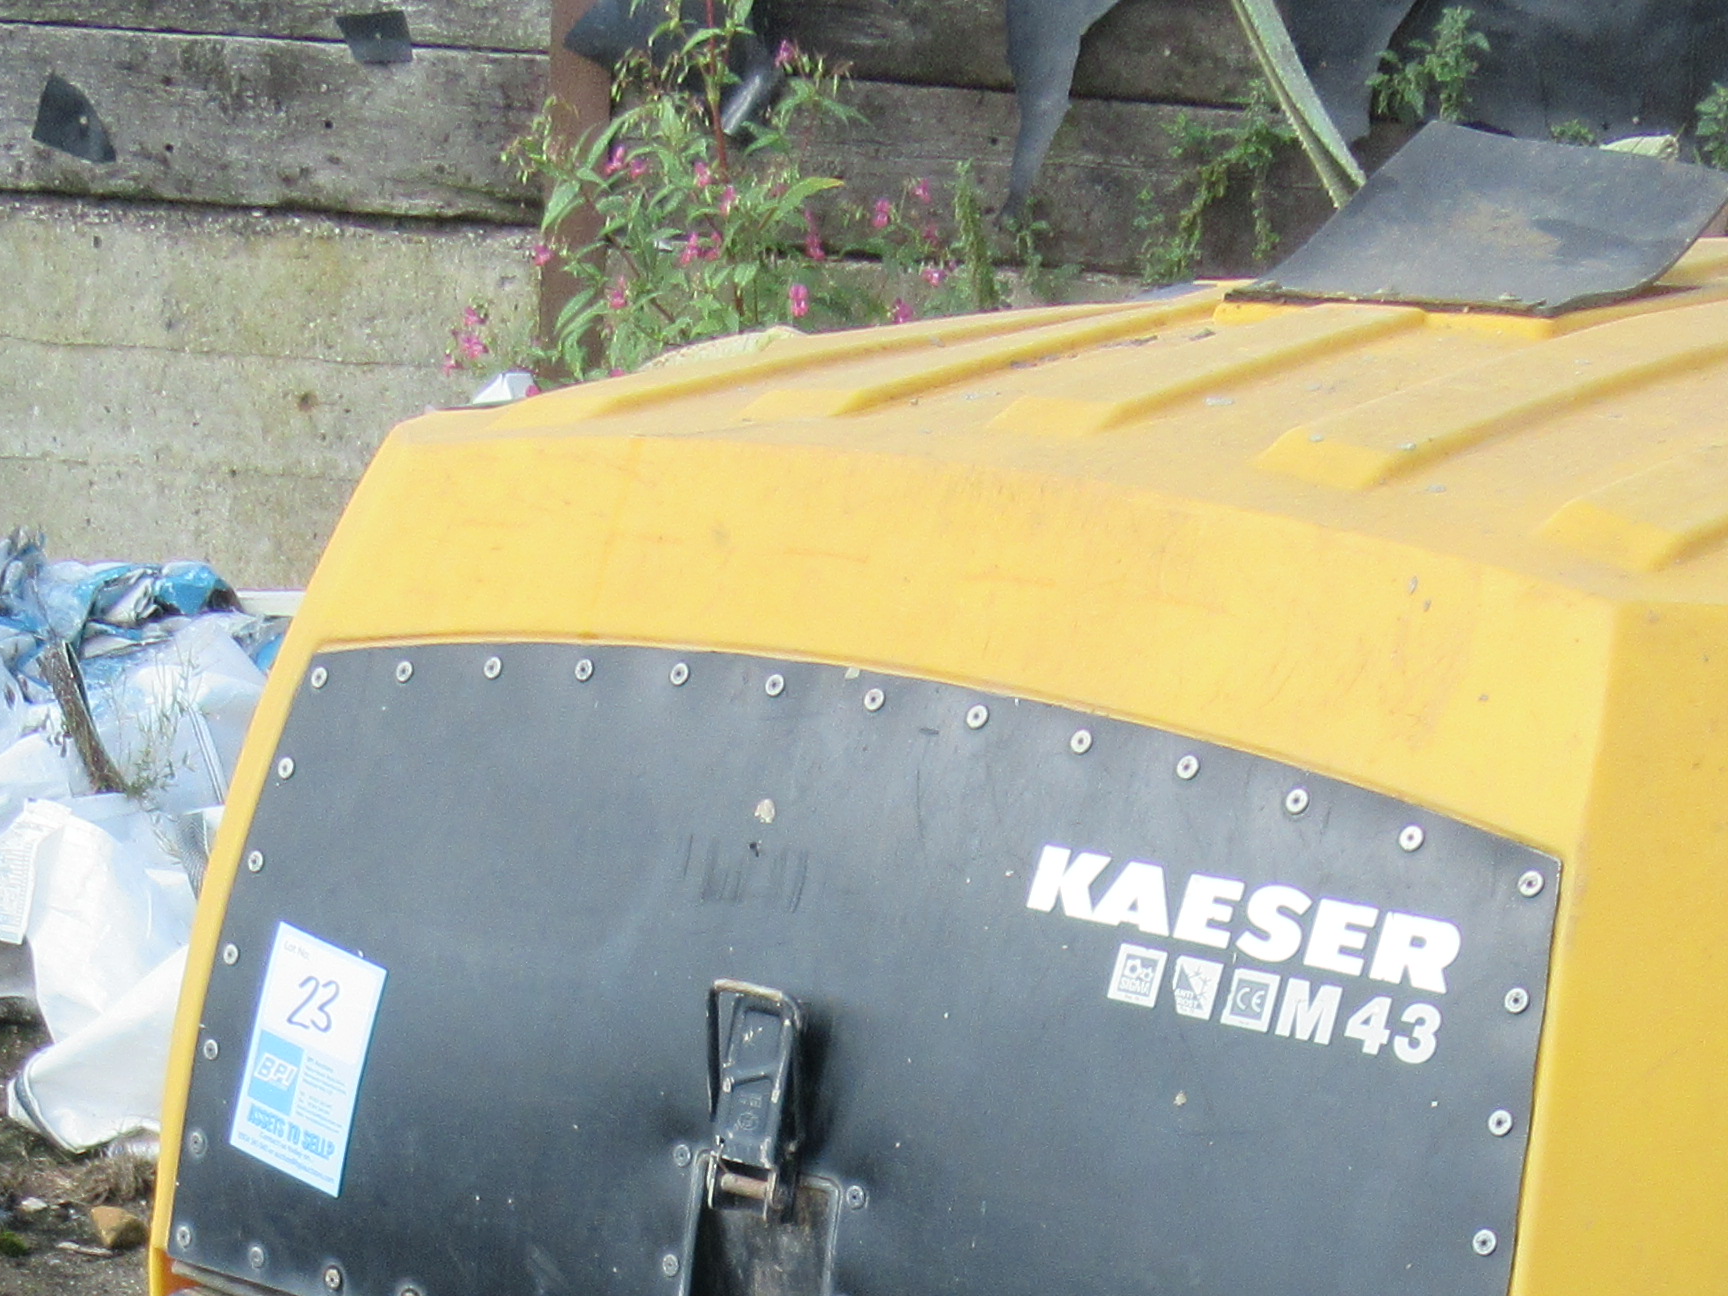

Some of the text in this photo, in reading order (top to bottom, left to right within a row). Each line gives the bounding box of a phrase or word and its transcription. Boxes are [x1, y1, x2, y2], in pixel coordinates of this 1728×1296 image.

[1026, 844, 1462, 994] KAESER
[283, 939, 297, 954] Lot
[286, 975, 340, 1034] 23
[256, 1054, 296, 1084] BPI
